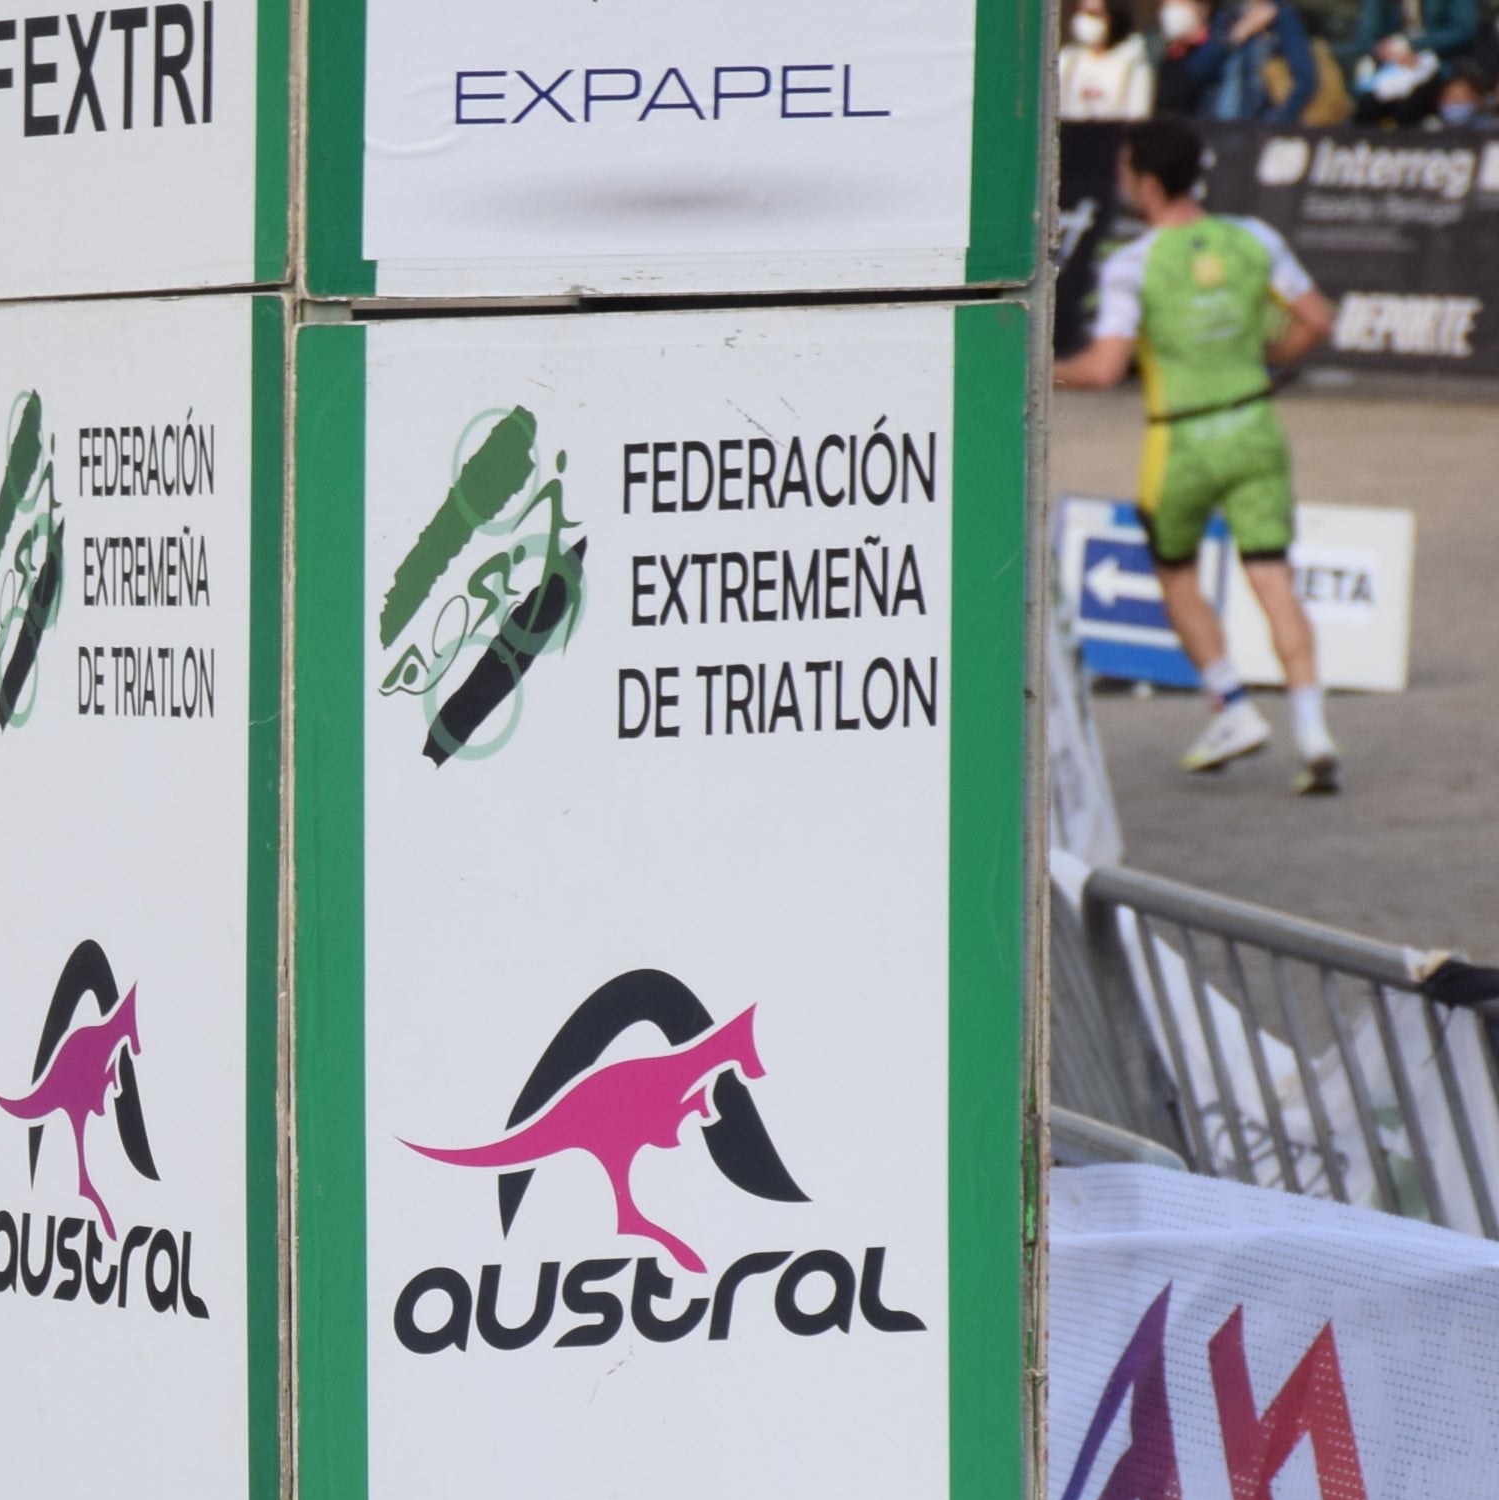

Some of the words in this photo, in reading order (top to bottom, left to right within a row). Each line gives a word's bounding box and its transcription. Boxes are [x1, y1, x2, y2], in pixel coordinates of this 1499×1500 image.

[454, 64, 891, 125] EXPAPEL
[79, 406, 214, 497] FEDERACIÓN
[623, 413, 936, 515] FEDERACIÓN
[83, 525, 210, 607] EXTREMEÑA
[631, 534, 927, 627] EXTREMEÑA
[1302, 567, 1374, 606] ETA
[77, 646, 106, 716] DE
[110, 646, 215, 719] TRIATLON
[617, 666, 681, 740] DE
[695, 656, 938, 737] TRIATLON
[393, 1246, 926, 1354] austral
